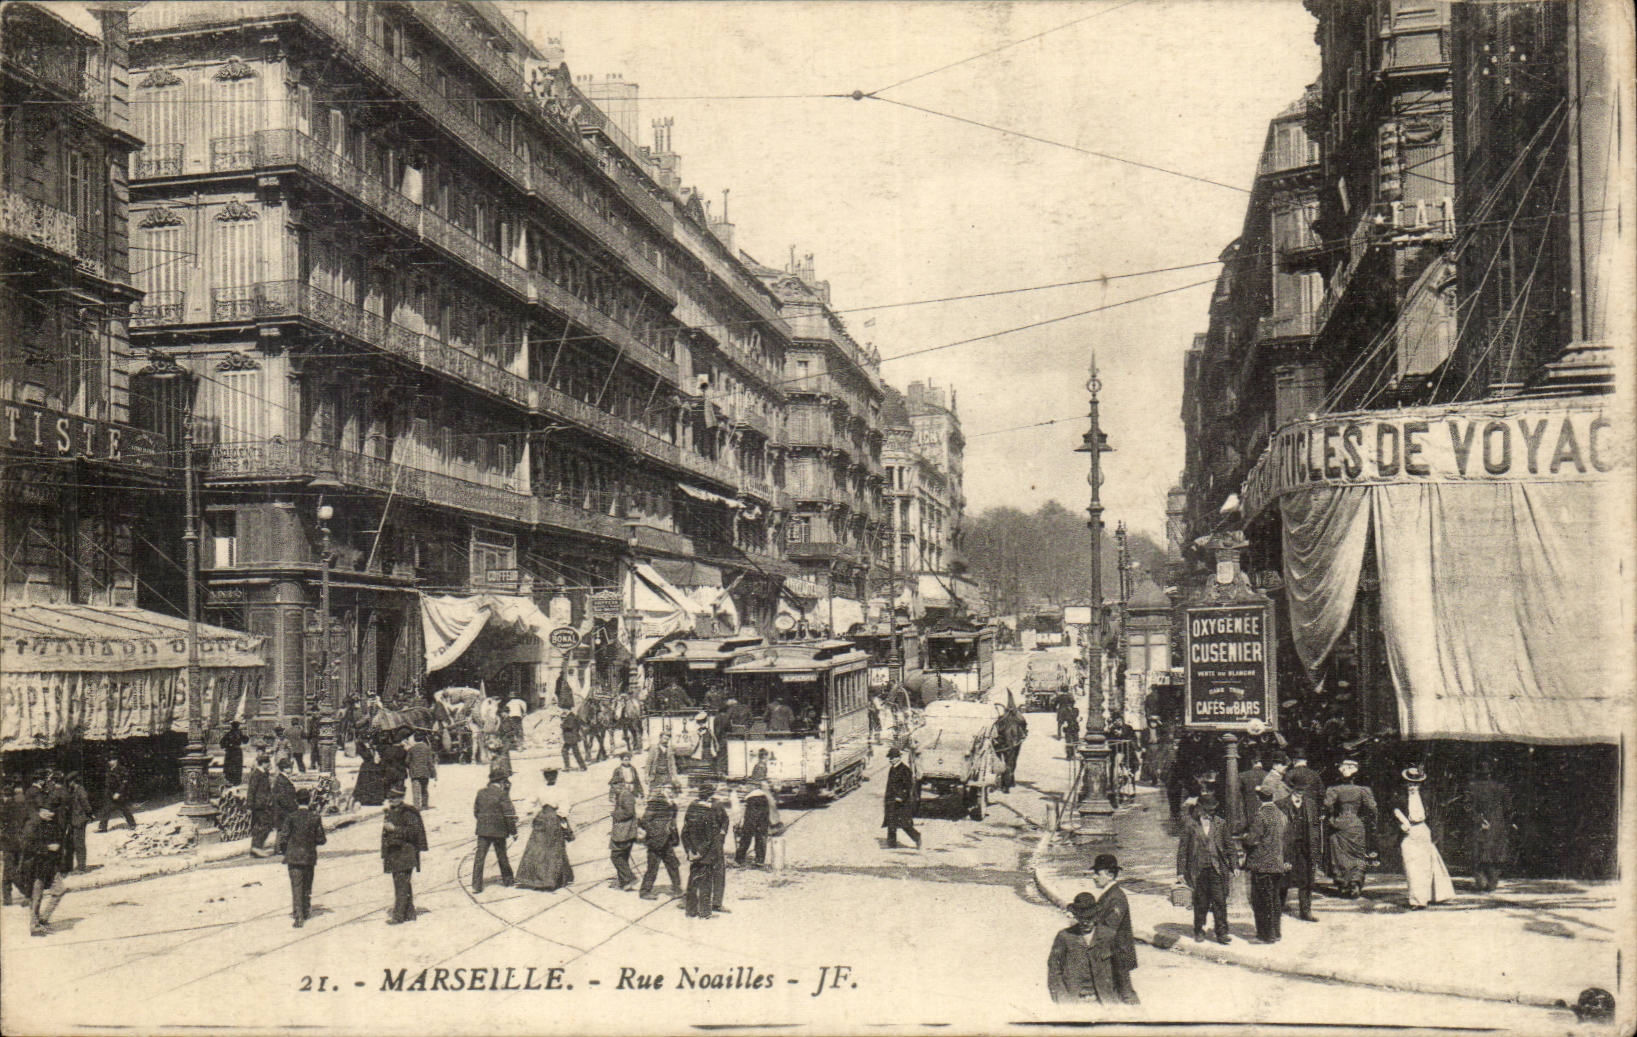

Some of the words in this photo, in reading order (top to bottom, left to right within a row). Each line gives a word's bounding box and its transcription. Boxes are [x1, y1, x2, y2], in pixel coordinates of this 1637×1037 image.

[5, 405, 122, 461] TISTE
[1376, 421, 1431, 477] DE
[551, 634, 577, 645] BONAL
[1191, 641, 1263, 663] CUSENIER
[1233, 701, 1260, 715] BARS
